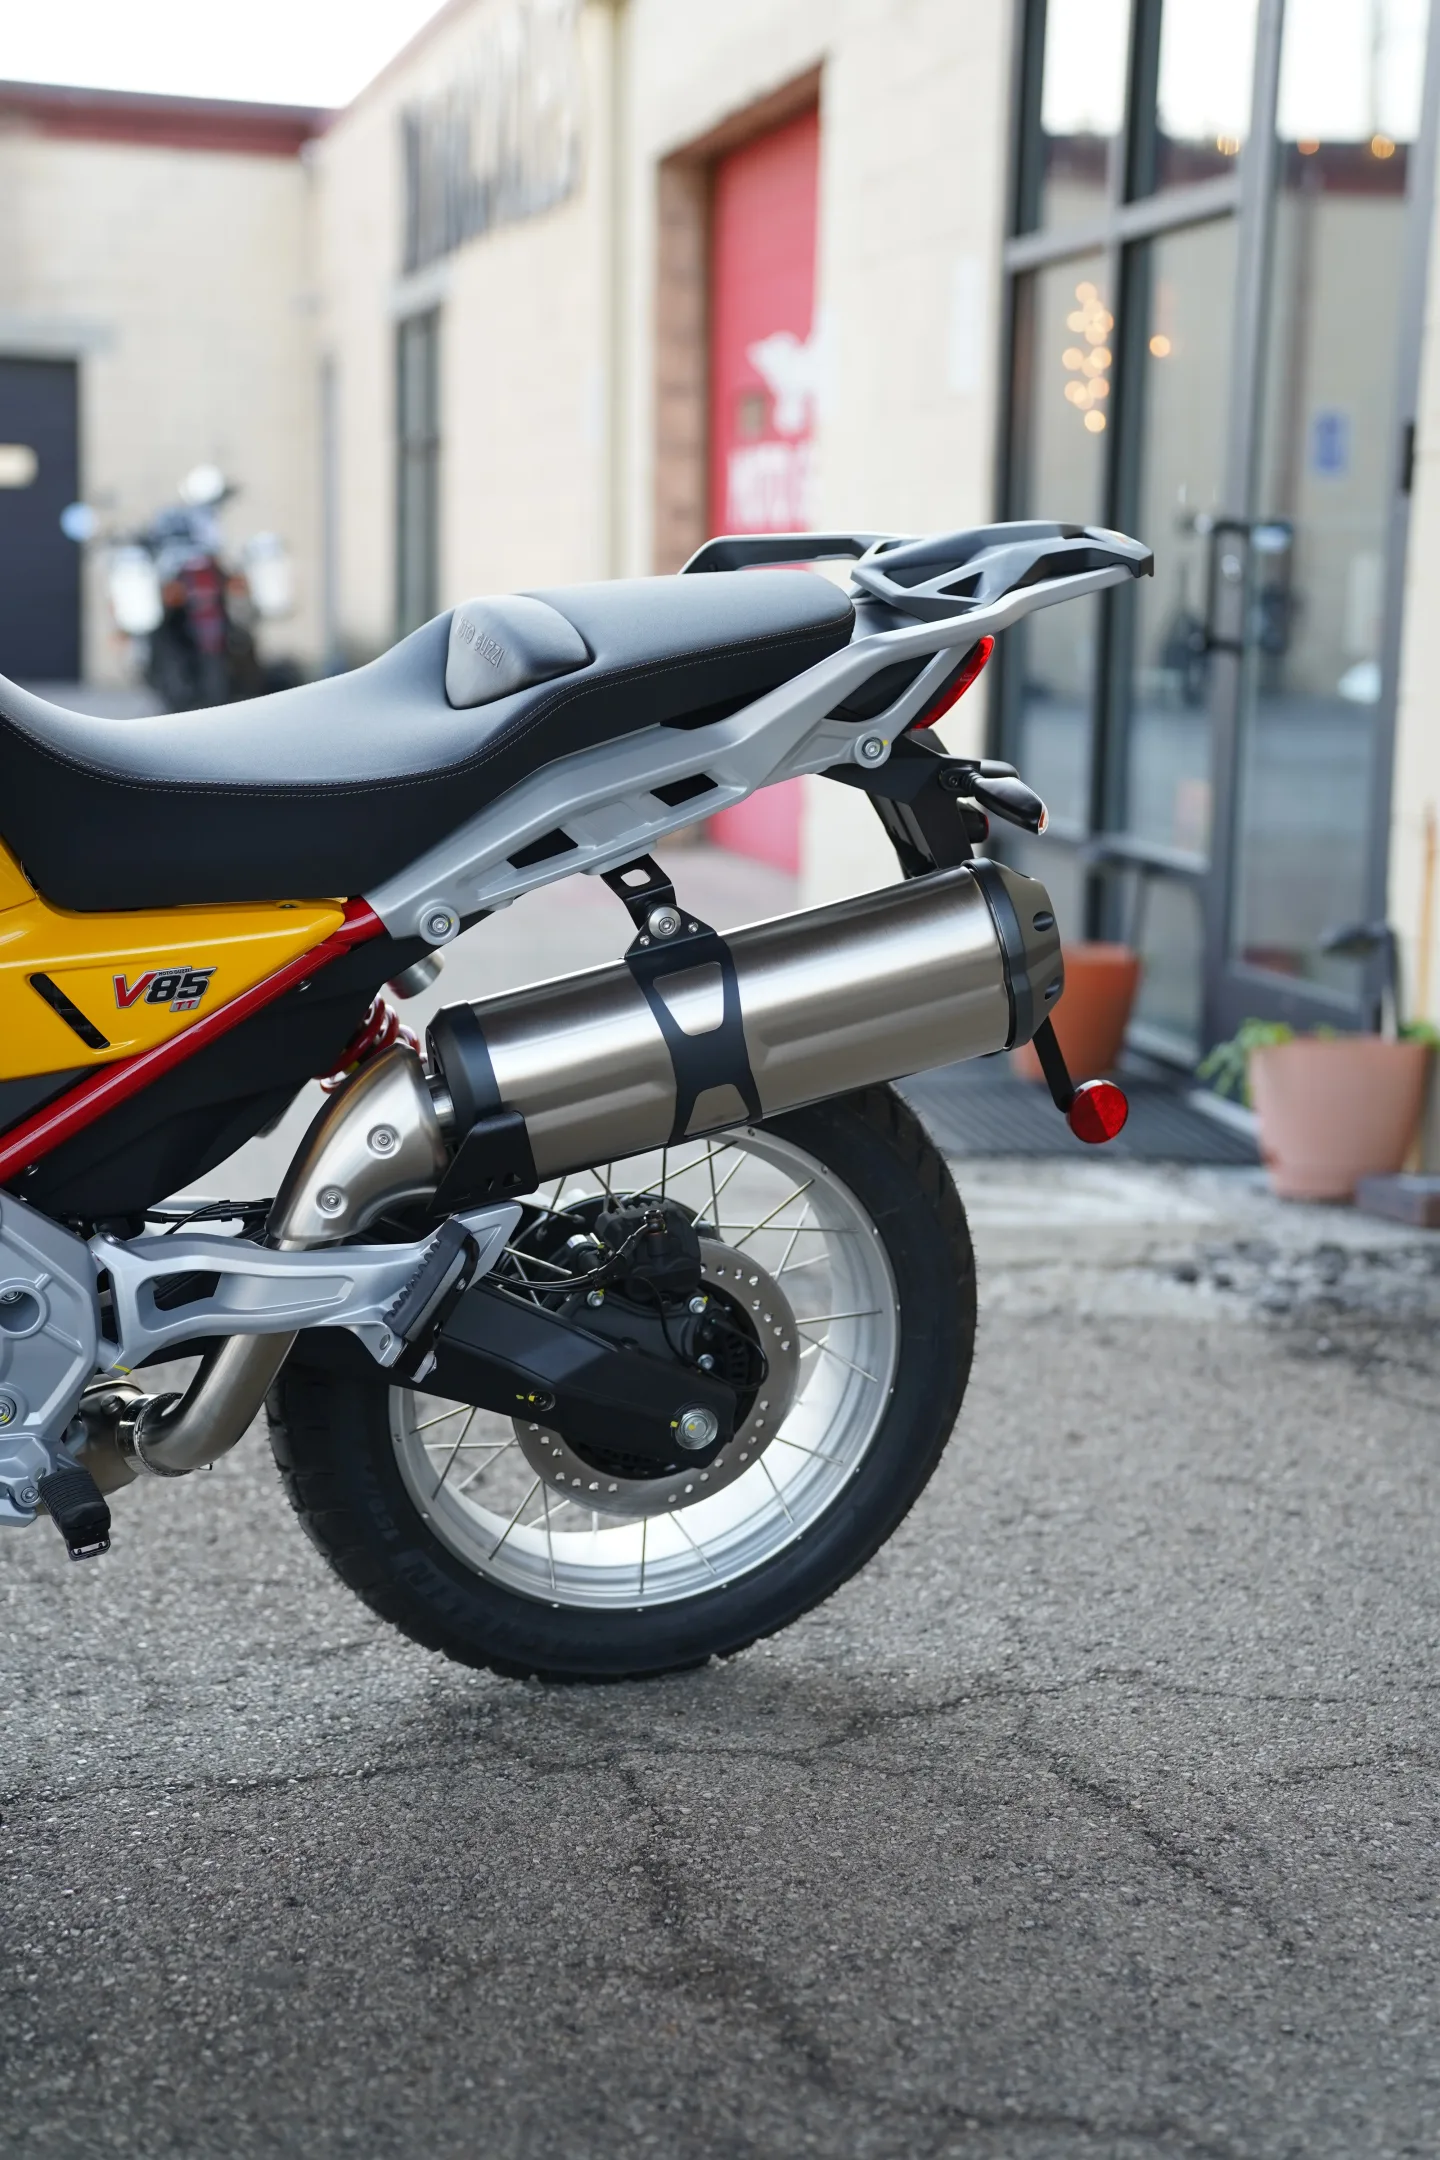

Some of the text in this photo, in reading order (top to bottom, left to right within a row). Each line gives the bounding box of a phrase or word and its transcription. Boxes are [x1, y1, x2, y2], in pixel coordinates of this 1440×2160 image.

[457, 617, 505, 668] OTO GUZZI
[114, 968, 216, 1008] V85
[176, 999, 196, 1011] TT
